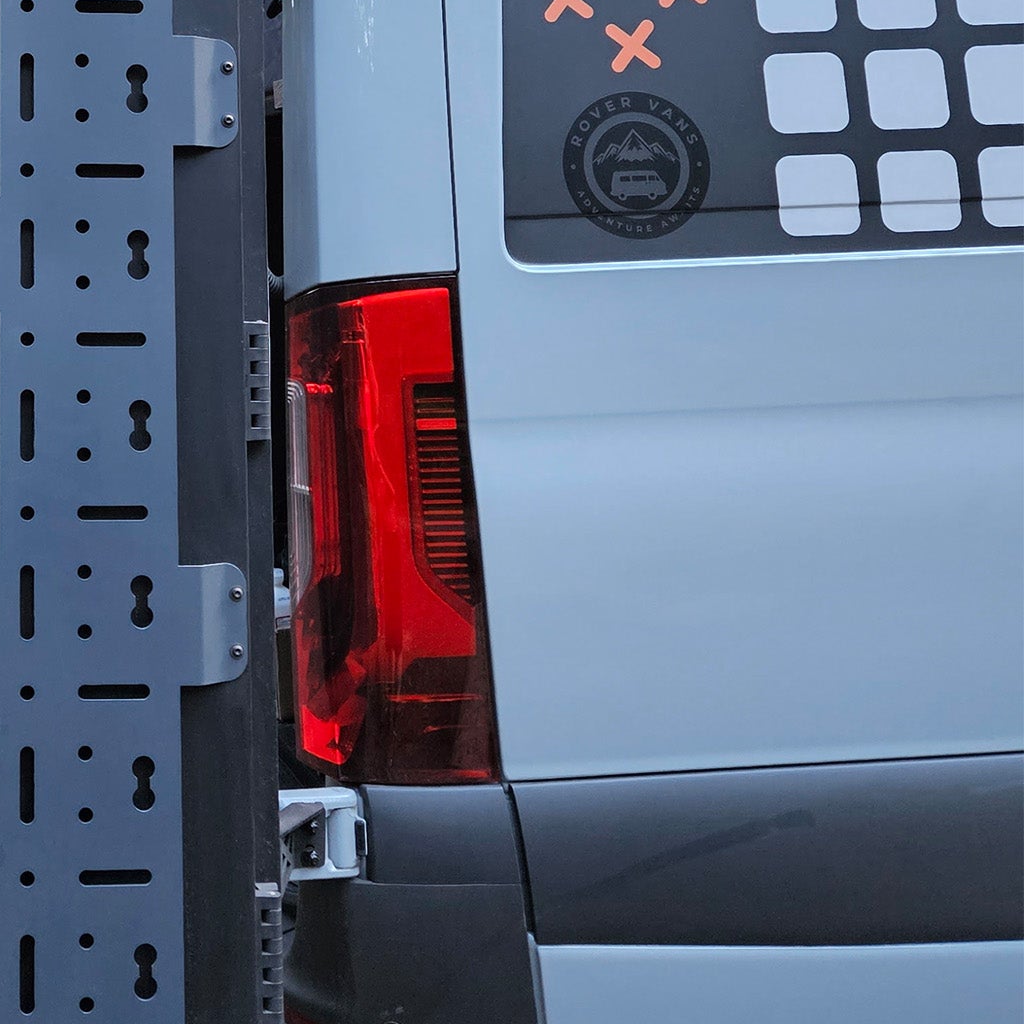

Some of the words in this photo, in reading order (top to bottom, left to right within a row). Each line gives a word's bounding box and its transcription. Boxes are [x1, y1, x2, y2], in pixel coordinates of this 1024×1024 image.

[570, 96, 631, 148] ROVER
[649, 99, 698, 145] VANS
[661, 186, 701, 228] AWITS
